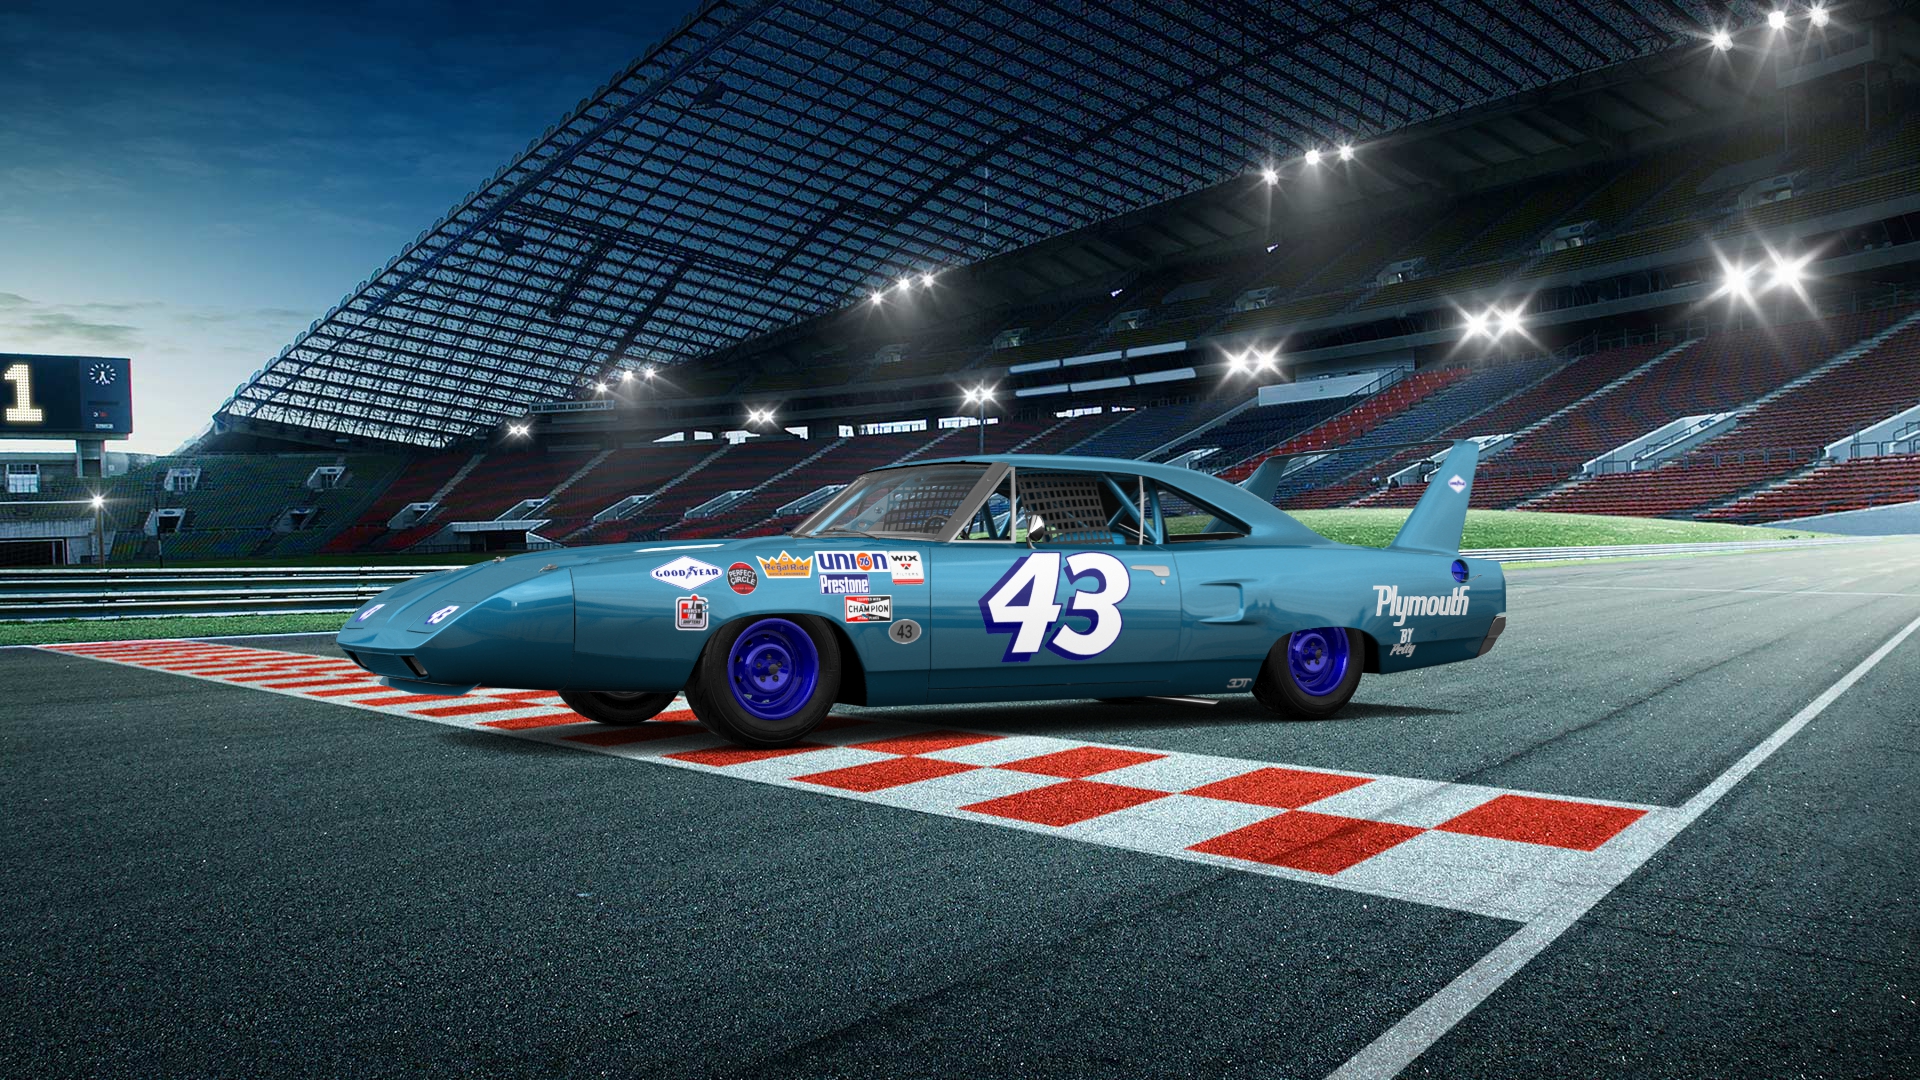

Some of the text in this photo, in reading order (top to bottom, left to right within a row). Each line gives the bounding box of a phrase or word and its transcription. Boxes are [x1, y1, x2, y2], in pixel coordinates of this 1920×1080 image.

[4, 364, 42, 421] 1
[728, 569, 756, 578] PERFECT
[730, 576, 756, 585] CIRCLE
[820, 574, 869, 593] Prestone
[848, 604, 889, 613] CHAMPION
[978, 551, 1131, 662] 43
[1372, 585, 1470, 627] Plymouth
[897, 624, 913, 639] 43
[1400, 627, 1415, 644] BY
[1389, 643, 1417, 657] Petty
